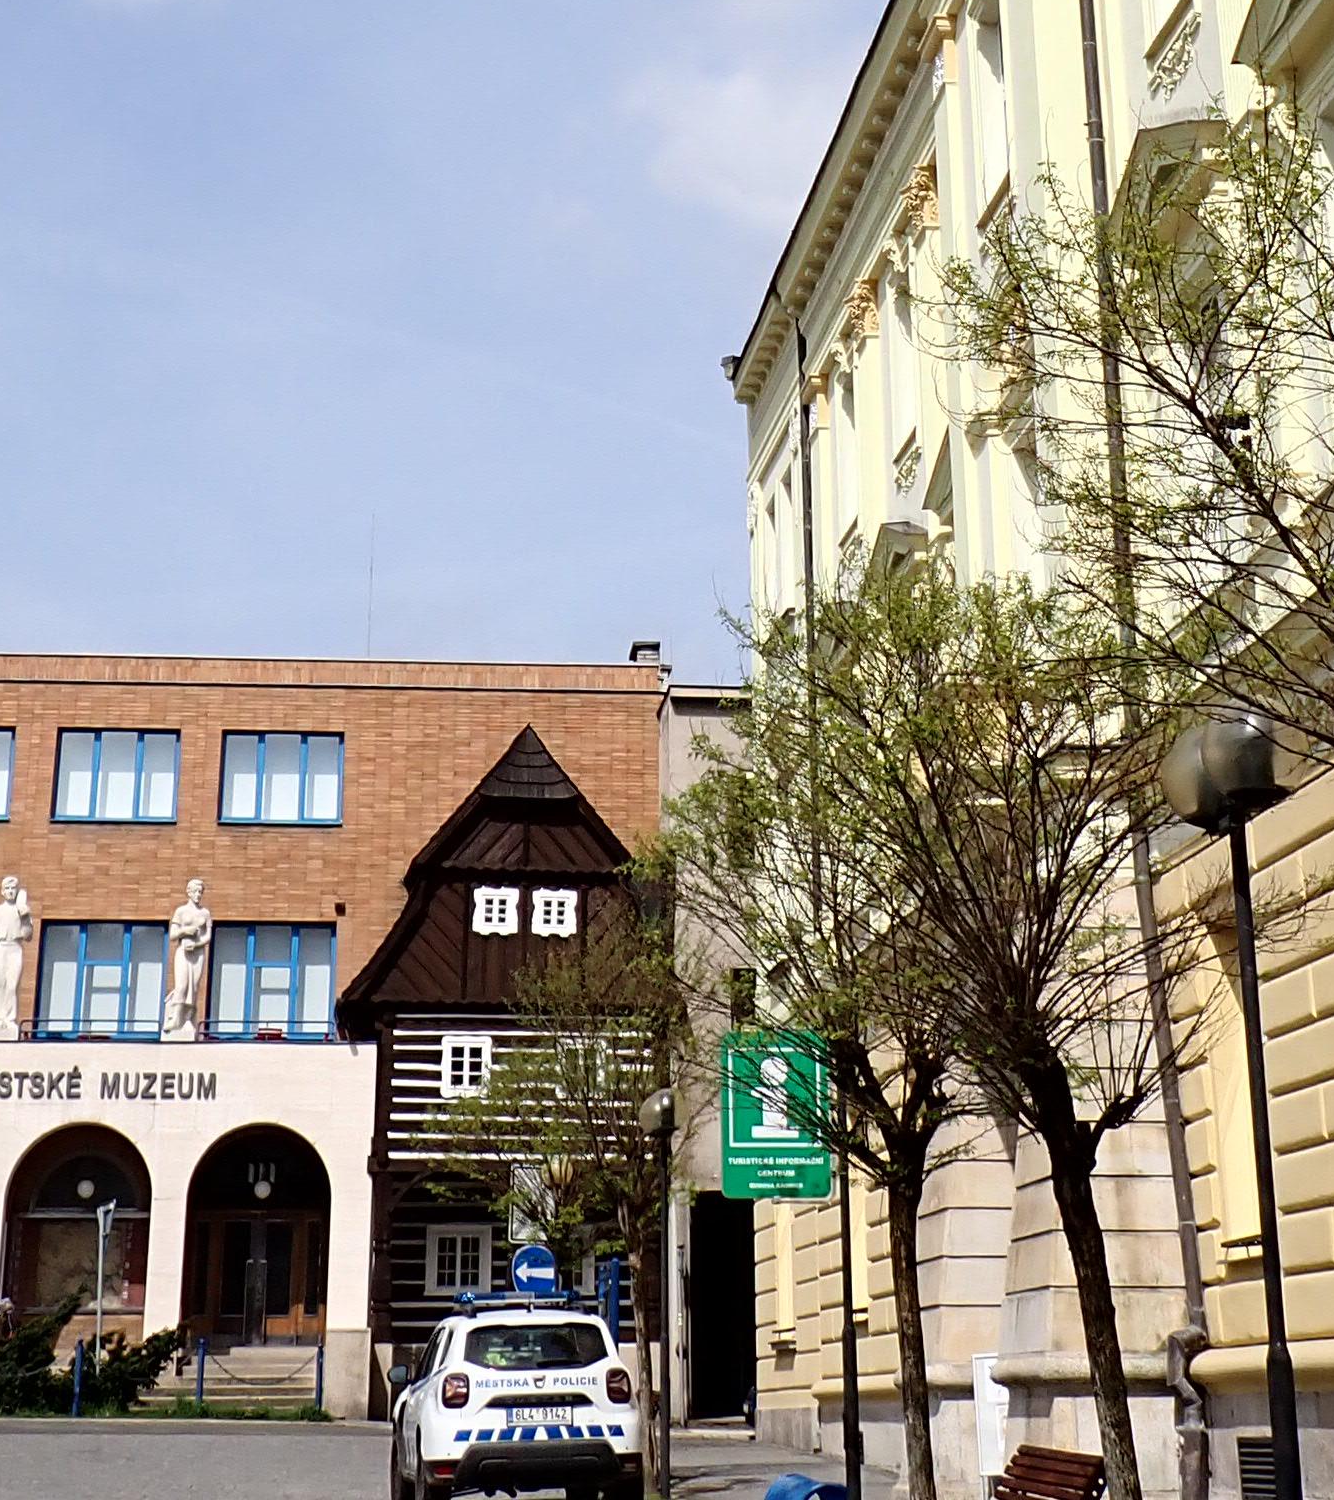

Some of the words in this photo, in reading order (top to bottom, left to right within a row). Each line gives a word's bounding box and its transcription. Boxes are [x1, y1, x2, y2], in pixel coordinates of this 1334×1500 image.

[99, 1071, 217, 1100] MUZEUM
[728, 1156, 774, 1165] TURISTICKÉ
[757, 1169, 795, 1177] CENTRUM
[553, 1376, 598, 1386] POLICIE
